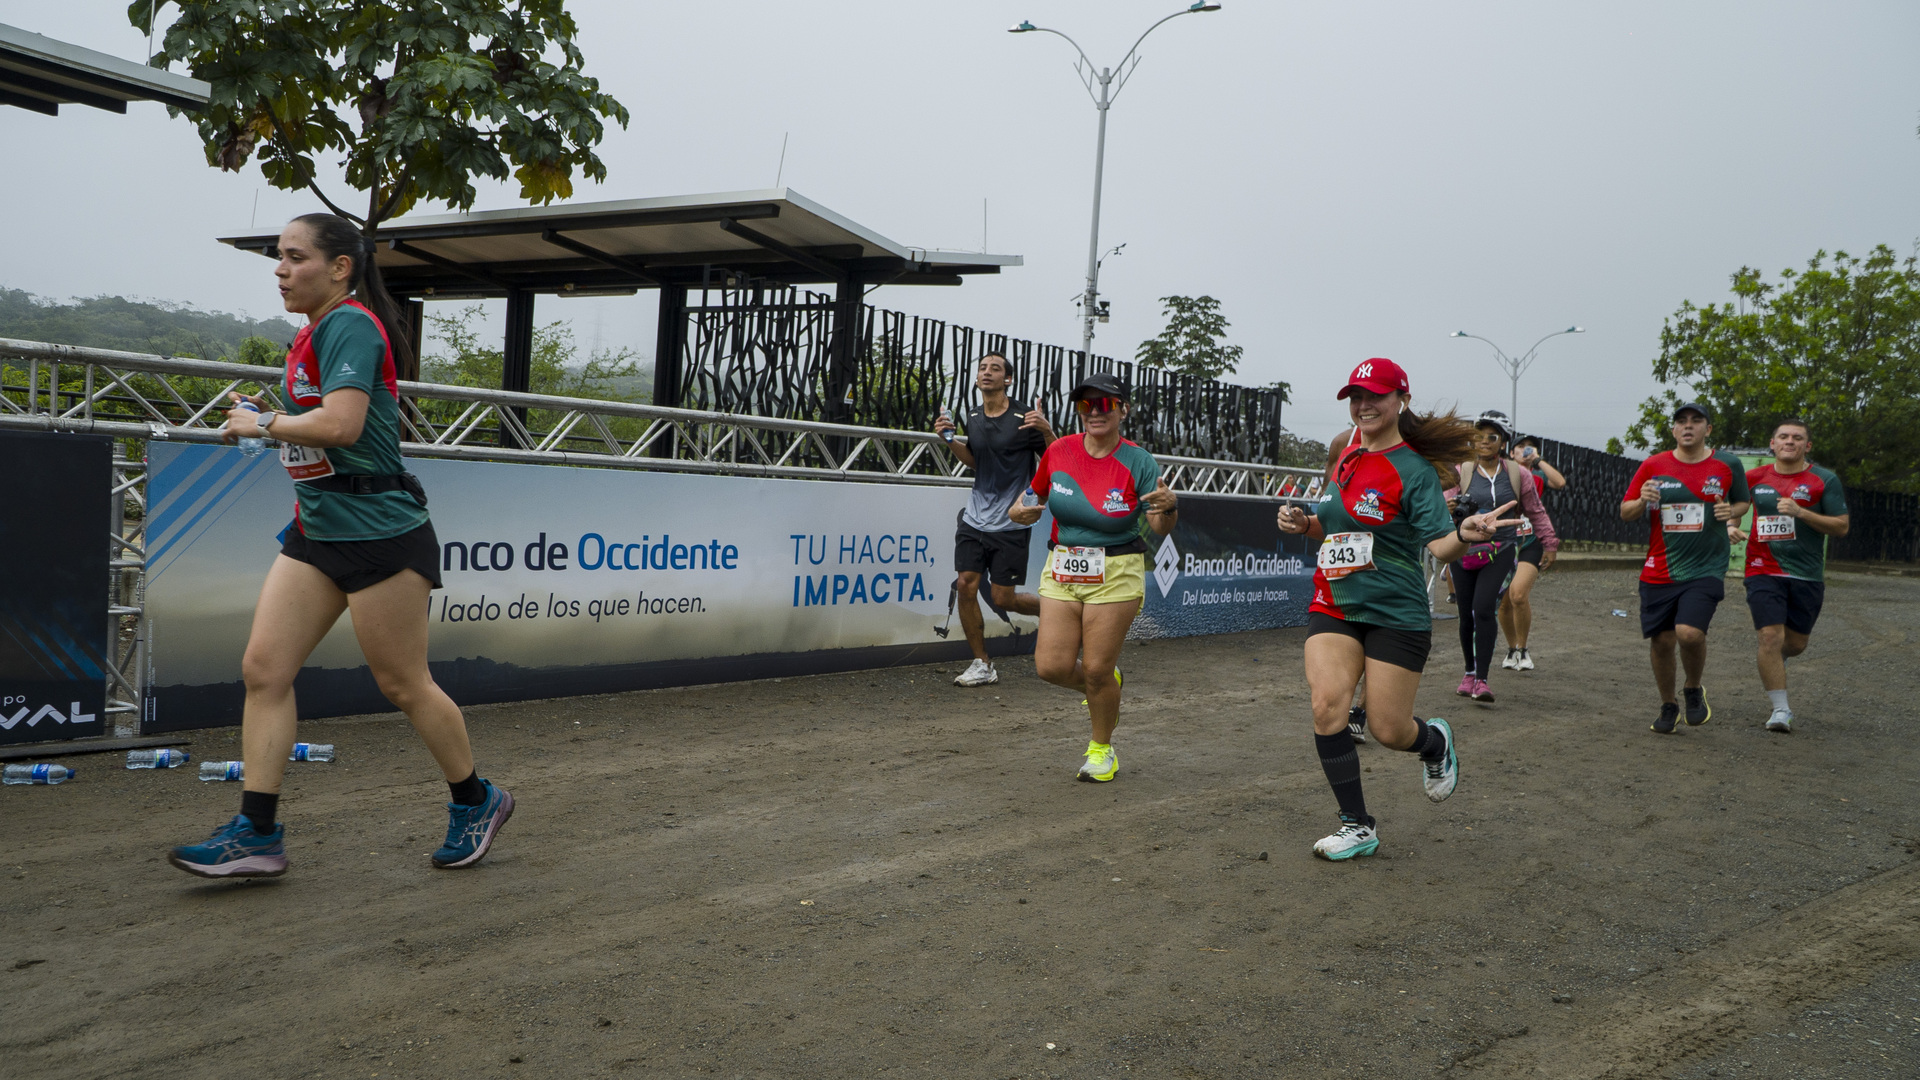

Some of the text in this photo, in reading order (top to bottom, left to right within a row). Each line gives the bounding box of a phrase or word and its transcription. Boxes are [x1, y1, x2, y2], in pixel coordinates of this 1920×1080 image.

[1675, 512, 1684, 523] 9
[1760, 524, 1787, 533] 1376
[443, 532, 739, 572] nco de Occidente
[790, 534, 935, 568] TU HACER,
[1328, 547, 1356, 565] 343
[1064, 558, 1089, 573] 499
[1184, 552, 1301, 577] Banco de Occidente
[793, 572, 934, 608] IMPACTA.
[1182, 587, 1289, 606] Del lado de los que hacen.
[440, 594, 501, 622] lado
[508, 592, 539, 620] de
[547, 592, 580, 618] los
[588, 597, 630, 623] que
[636, 590, 706, 615] hacen.
